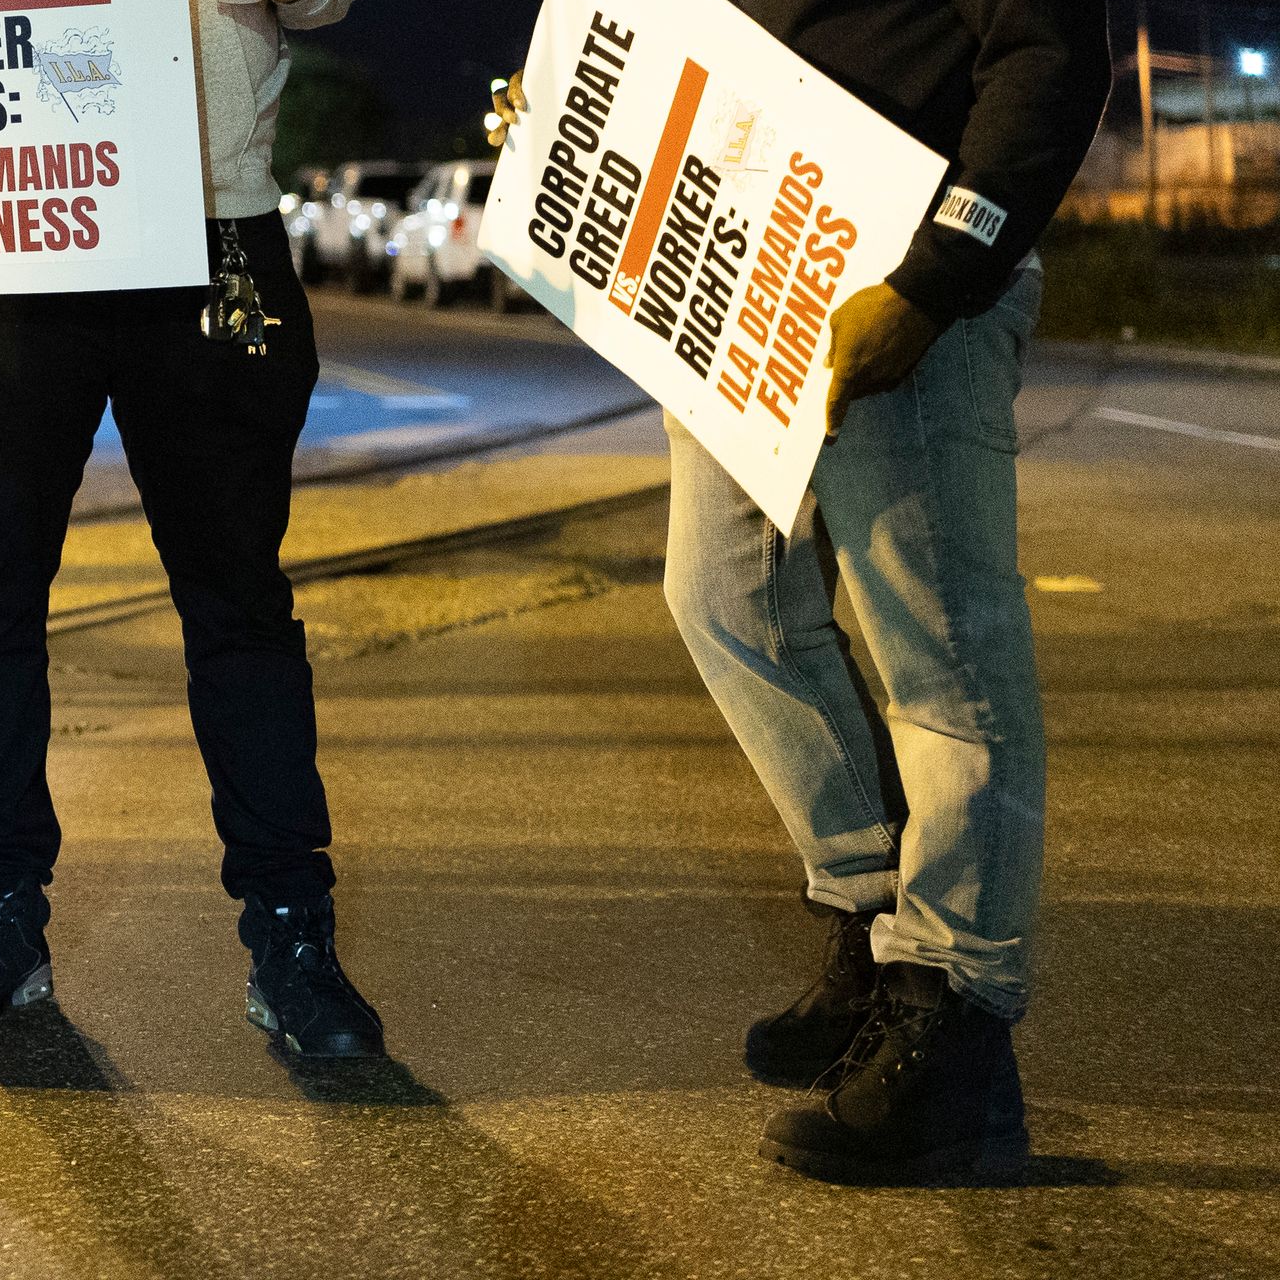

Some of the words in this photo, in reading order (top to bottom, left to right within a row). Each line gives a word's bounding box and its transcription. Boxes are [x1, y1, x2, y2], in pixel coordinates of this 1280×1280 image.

[48, 60, 111, 83] I.L.A.
[528, 10, 635, 259] CORPORATE
[569, 149, 642, 291] GREED
[611, 271, 641, 305] VS.
[634, 154, 722, 342] WORKER
[675, 207, 749, 381] RIGHTS:
[737, 151, 824, 348] DEMANDS
[716, 342, 759, 414] ILA
[757, 204, 858, 428] FAIRNESS
